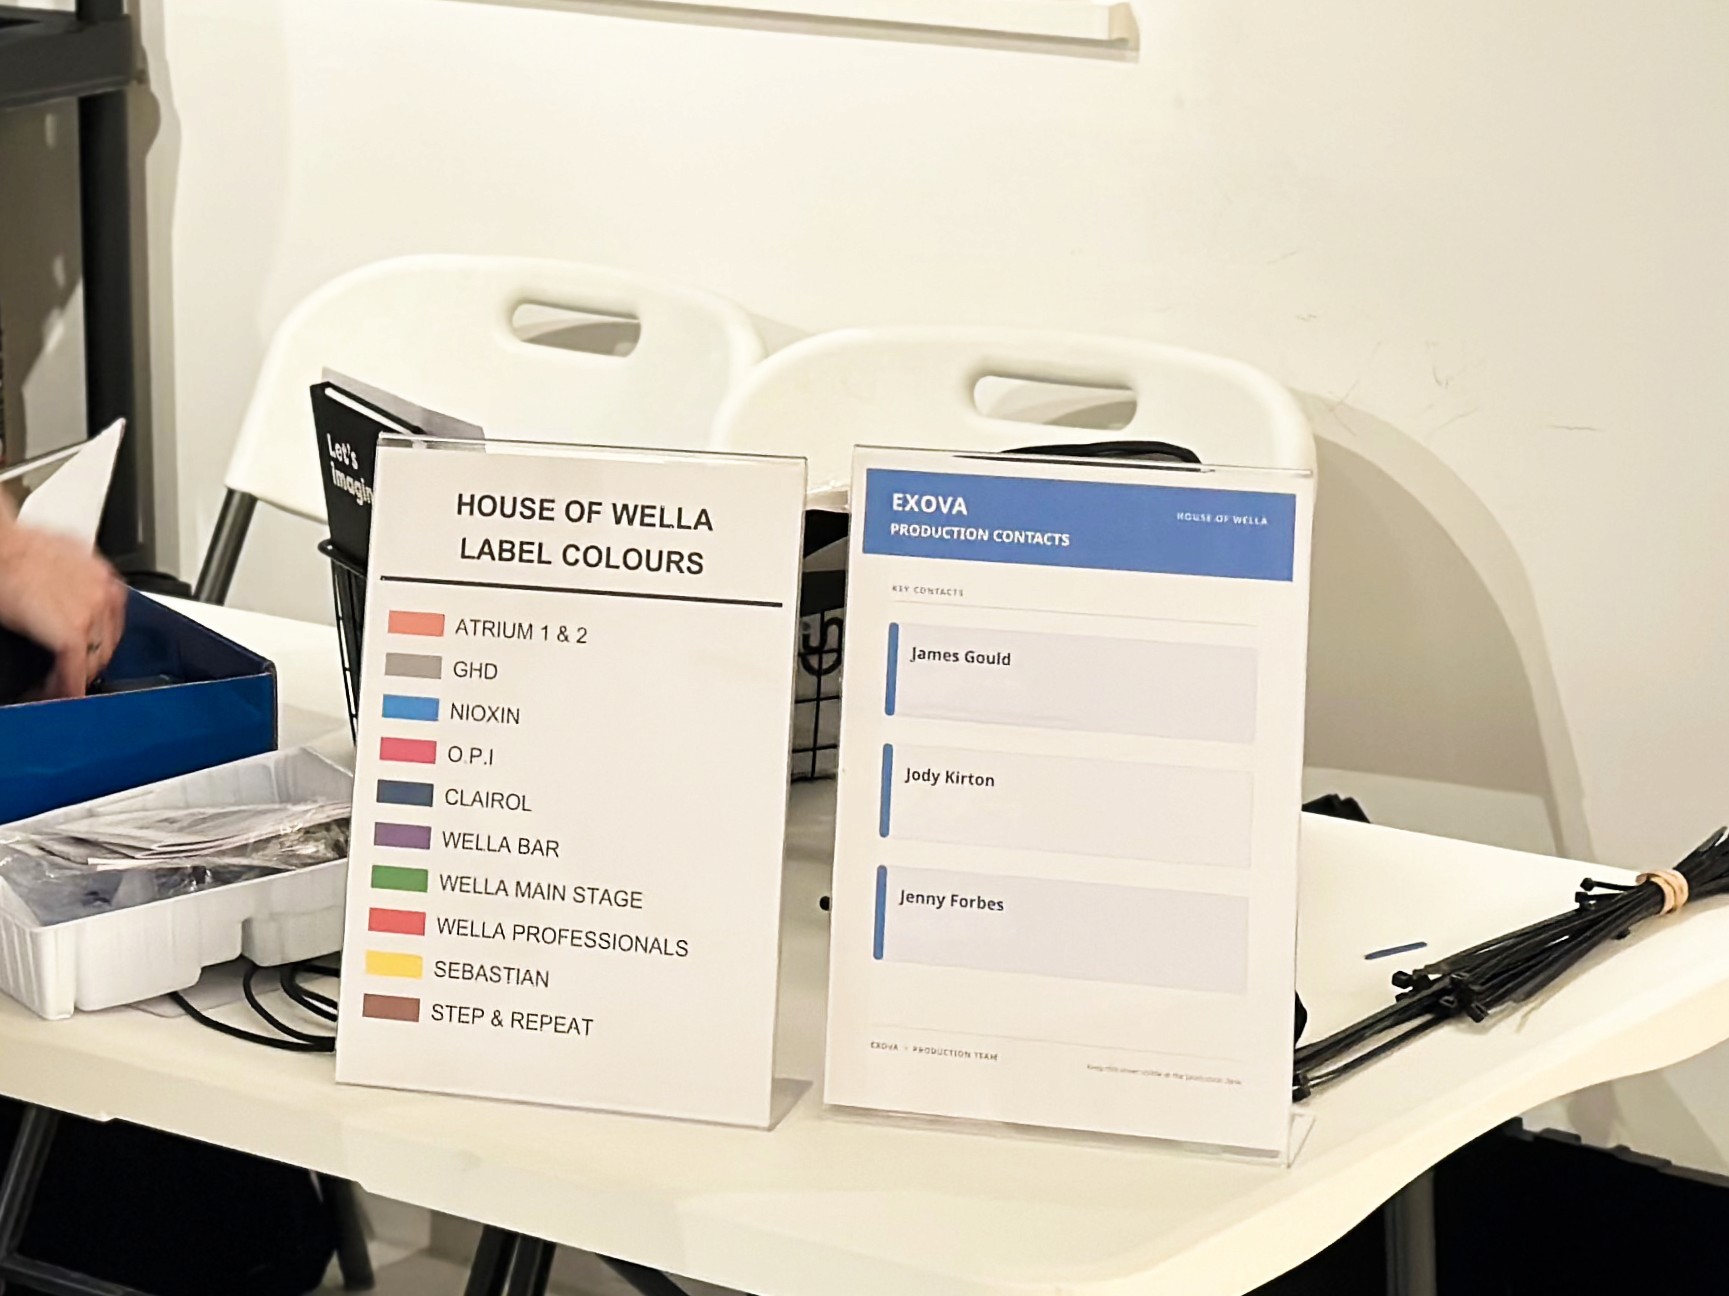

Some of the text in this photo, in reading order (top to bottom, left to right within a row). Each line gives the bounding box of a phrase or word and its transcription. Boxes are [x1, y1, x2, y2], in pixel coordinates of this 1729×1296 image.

[327, 433, 358, 470] Let's
[457, 493, 714, 532] HOUSE OF WELLA
[892, 493, 968, 516] EXOVA
[1232, 515, 1268, 525] WELLA
[890, 522, 1070, 547] PRODUCTION CONTACTS
[460, 537, 704, 575] LABEL COLOURS
[455, 618, 588, 644] ATRIUM 1 & 2
[909, 646, 1011, 666] James Gould
[453, 660, 498, 680] GHD
[450, 702, 520, 725] NIOXIN
[447, 745, 493, 766] O.P.I
[904, 767, 995, 787] Jody Kirton
[445, 788, 532, 812] CLAIROL
[442, 830, 559, 858] WELLA BAR
[439, 874, 643, 910] WELLA MAIN STAGE
[899, 889, 1004, 912] Jenny Forbes
[437, 917, 689, 958] WELLA PROFESSIONALS
[434, 960, 549, 988] SEBASTIAN
[431, 1003, 594, 1036] STEP & REPEAT
